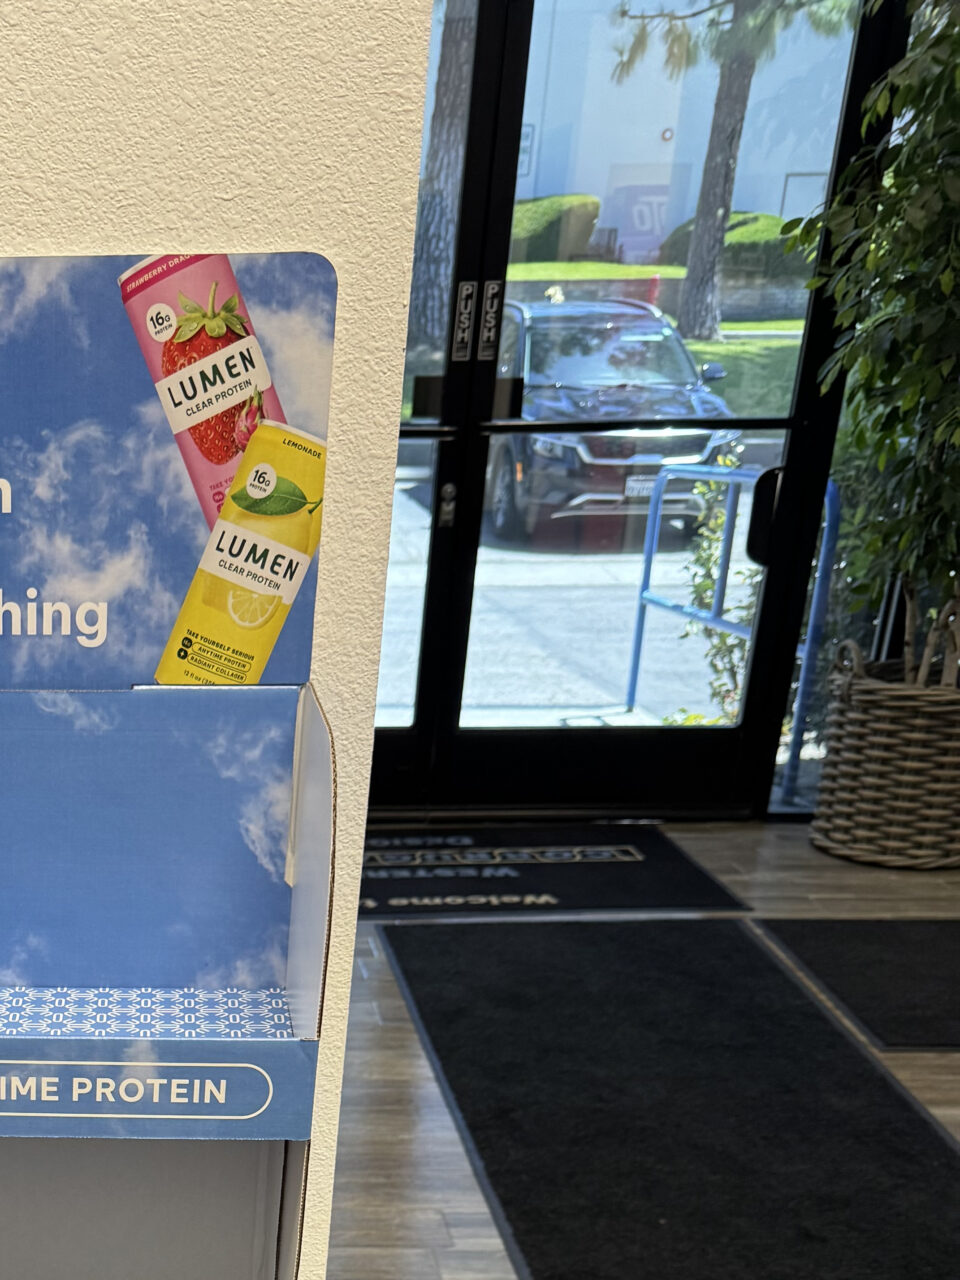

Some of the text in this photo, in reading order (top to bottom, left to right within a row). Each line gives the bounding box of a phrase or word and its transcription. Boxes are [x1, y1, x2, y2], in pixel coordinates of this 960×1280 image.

[126, 263, 168, 293] STRAWBERRY
[150, 311, 171, 330] 16G
[457, 284, 473, 342] PUSH
[482, 284, 499, 342] PUSH
[154, 323, 173, 336] PROTEIN
[167, 347, 256, 408] LUMEN
[185, 379, 252, 417] CLEAR PROTEIN
[282, 438, 322, 460] LEMONADE
[215, 530, 300, 582] LUMEN
[218, 559, 281, 591] CLEAR PROTEIN
[71, 1074, 228, 1105] PROTEIN
